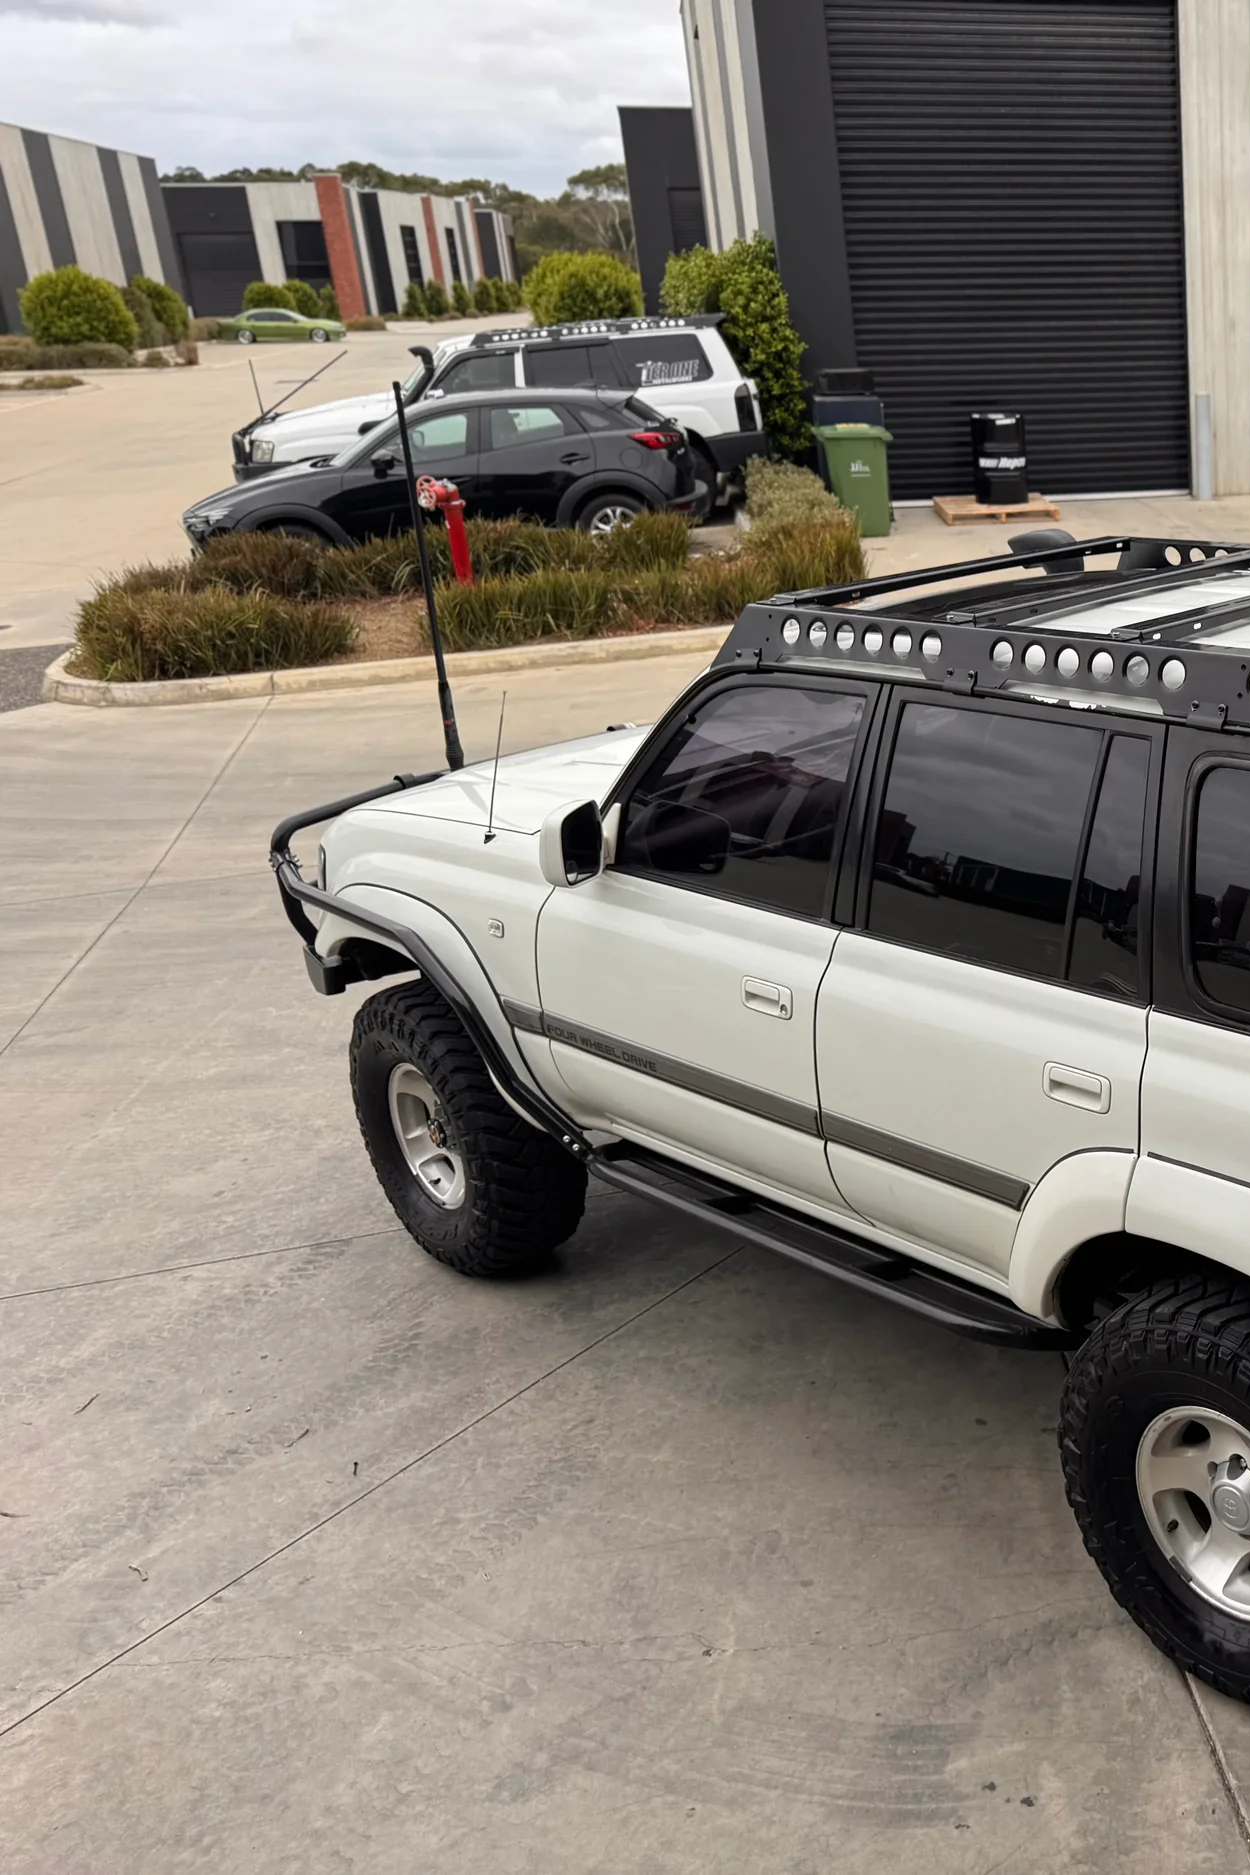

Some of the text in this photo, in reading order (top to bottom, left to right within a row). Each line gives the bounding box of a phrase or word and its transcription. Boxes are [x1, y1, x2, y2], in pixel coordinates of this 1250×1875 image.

[546, 1023, 658, 1073] FOUR WHEEL DRIVE
